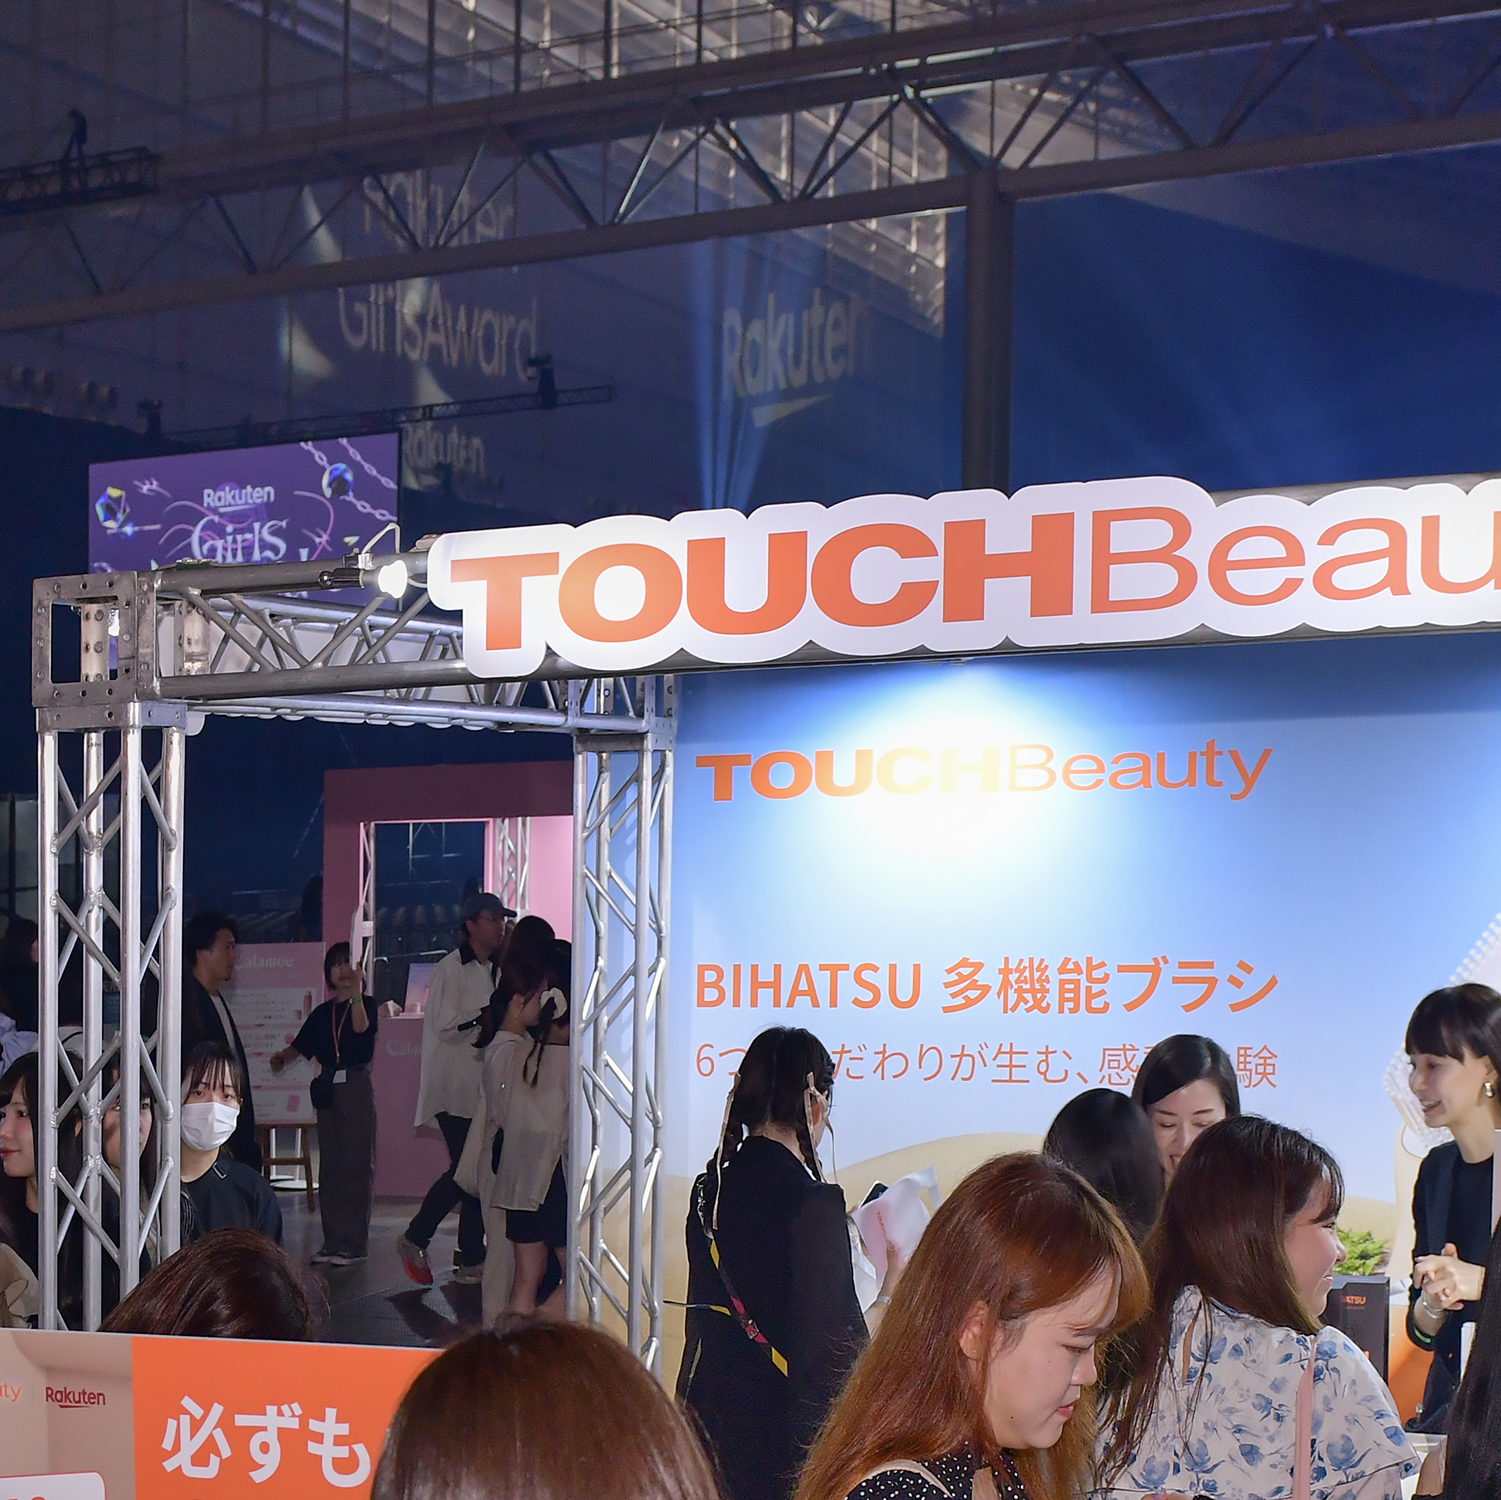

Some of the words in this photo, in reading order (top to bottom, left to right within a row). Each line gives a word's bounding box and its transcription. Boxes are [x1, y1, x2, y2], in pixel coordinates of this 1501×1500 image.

[202, 484, 275, 508] Rakuten
[695, 738, 1274, 801] TOUCHBeauty
[696, 962, 922, 1009] BIHATSU
[941, 954, 1279, 1015] 多機能ブラシ
[45, 1386, 106, 1407] Rakuten
[161, 1395, 372, 1489] 必ずも
